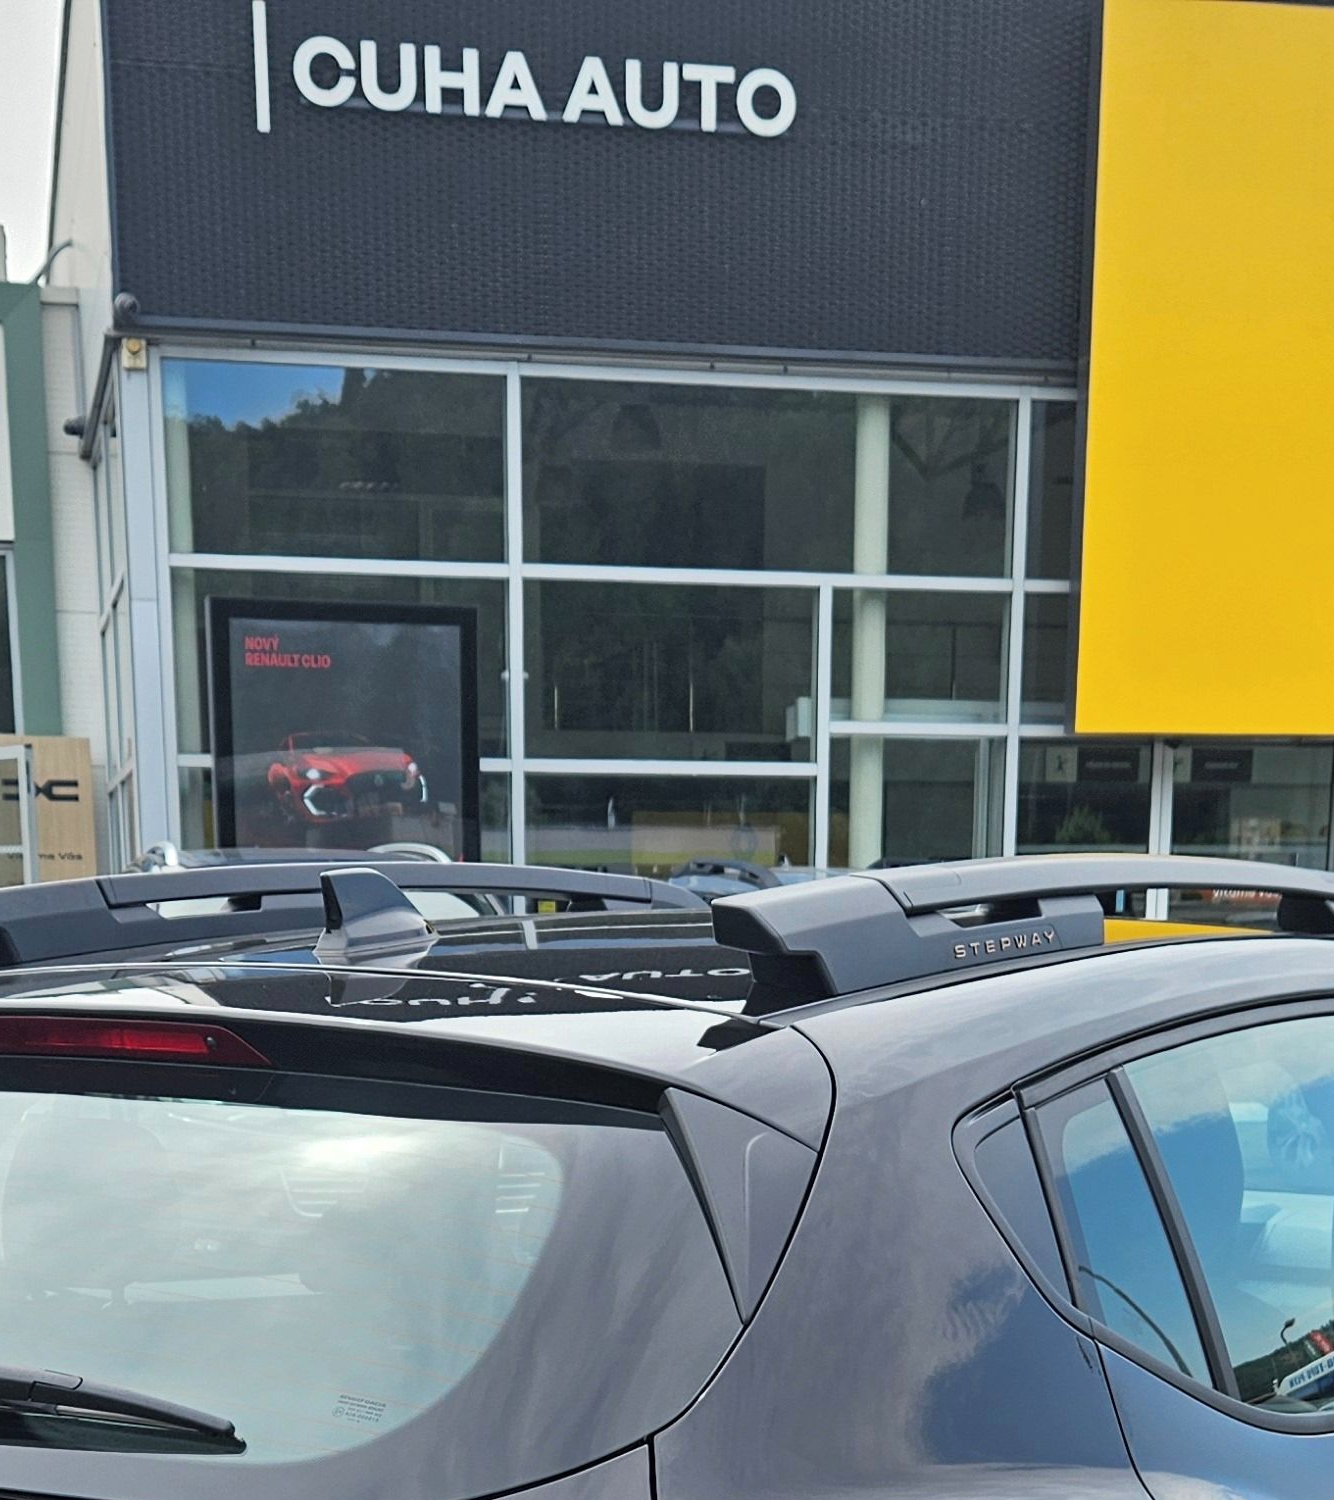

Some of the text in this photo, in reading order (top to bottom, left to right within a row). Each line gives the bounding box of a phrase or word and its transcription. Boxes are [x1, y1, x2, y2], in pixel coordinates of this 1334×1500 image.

[291, 35, 798, 138] CUHA AUTO
[245, 652, 331, 668] RENAULT CLIO
[953, 929, 1056, 959] STEPWAY
